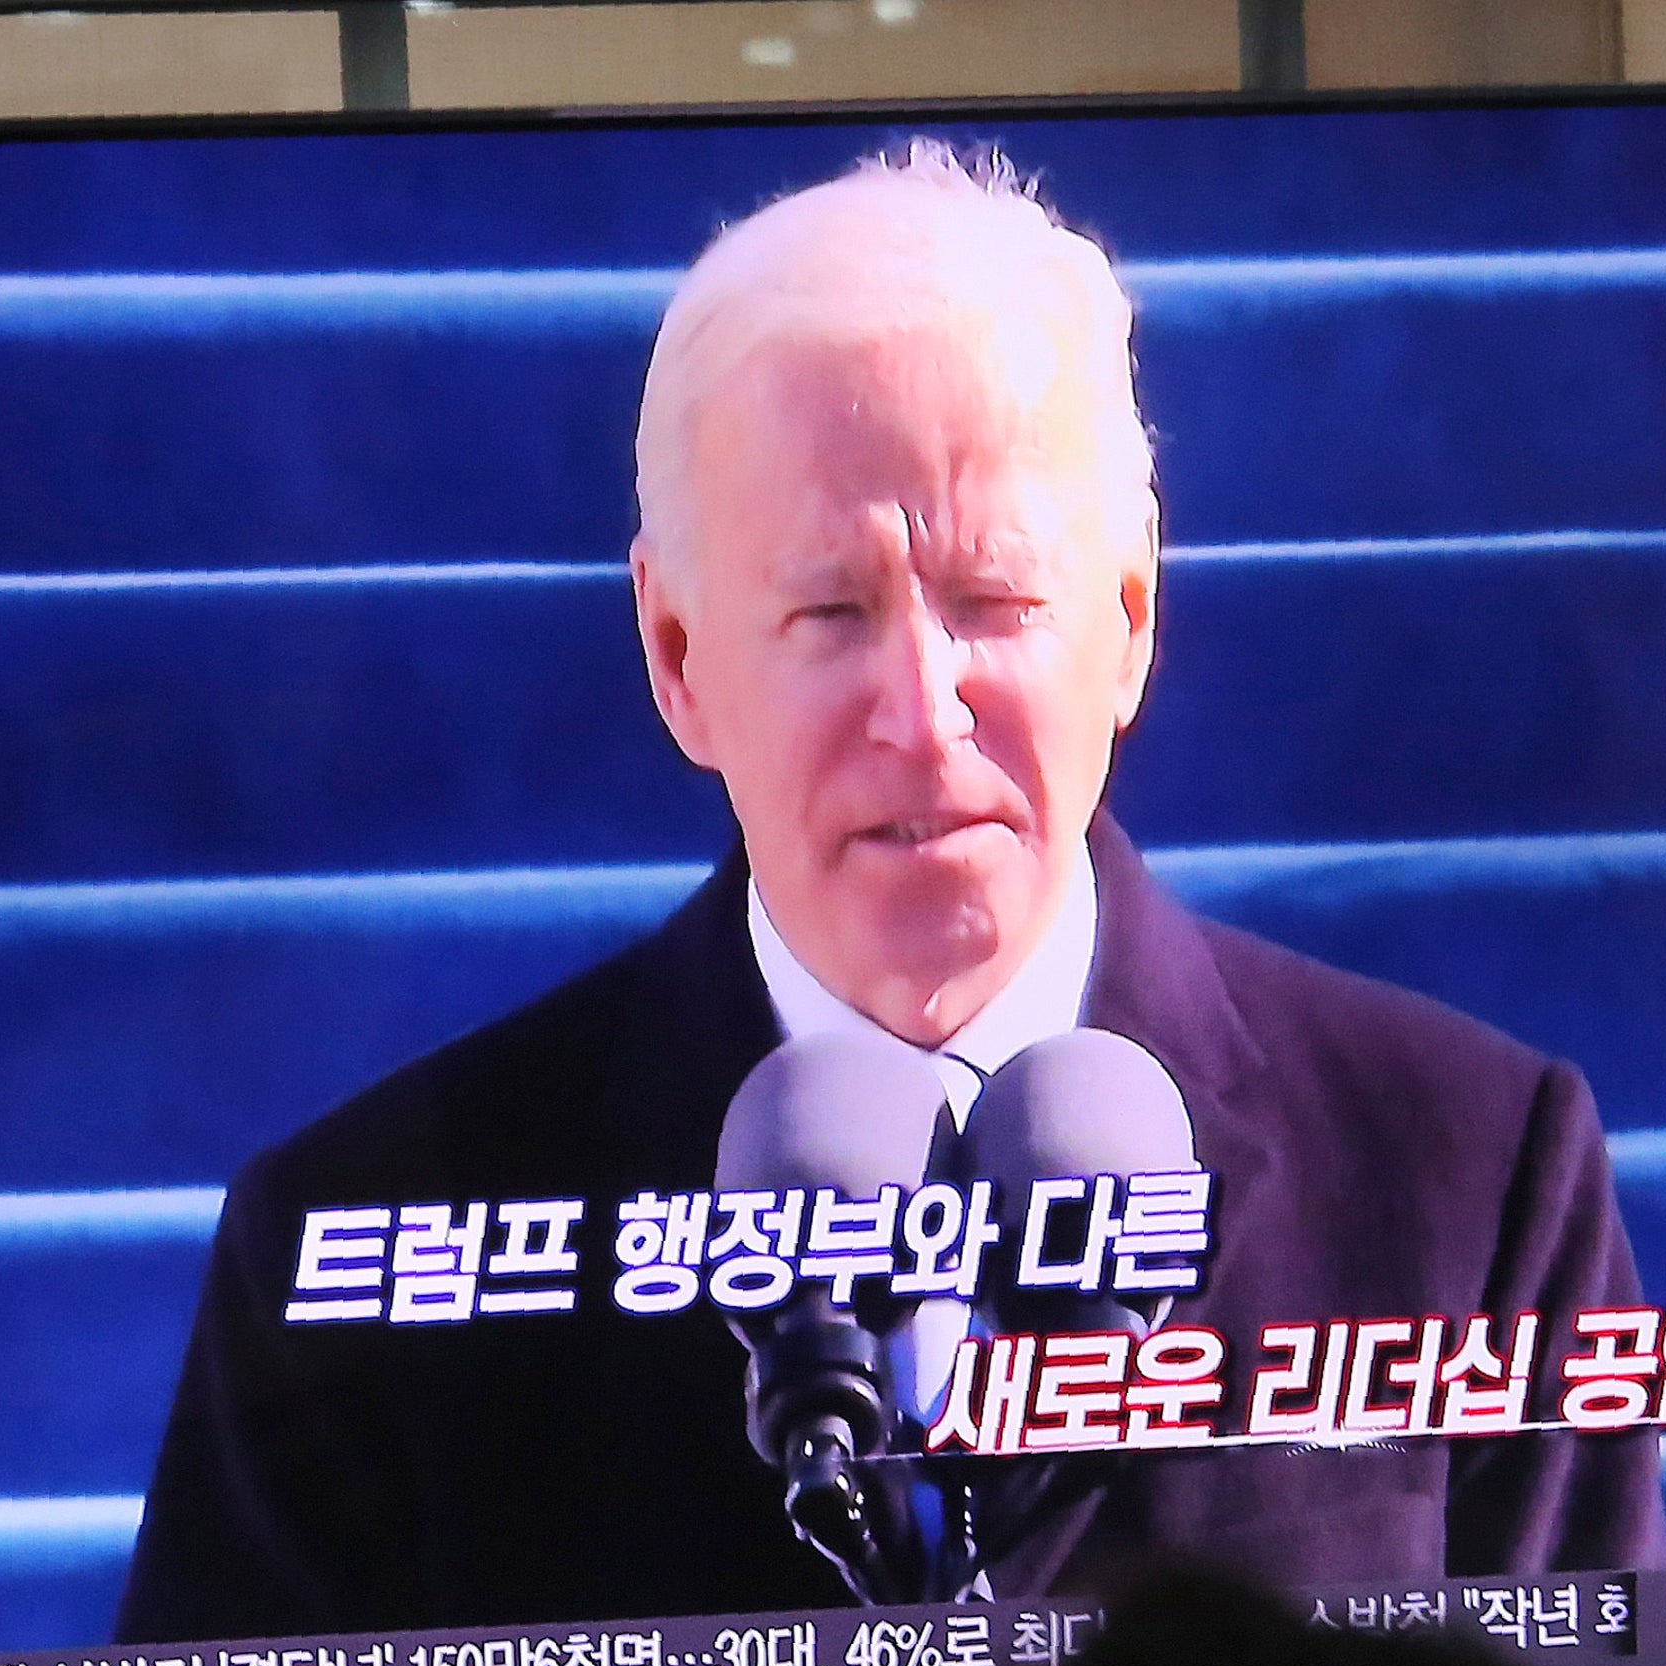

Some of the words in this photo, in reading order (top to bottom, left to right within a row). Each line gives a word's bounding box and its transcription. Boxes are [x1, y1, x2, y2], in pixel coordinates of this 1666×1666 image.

[283, 1199, 585, 1323] 트럼프
[610, 1182, 1001, 1313] 행정부와
[1015, 1170, 1213, 1291] 다른
[926, 1330, 1225, 1455] 새로운
[1249, 1314, 1539, 1436] 리더십
